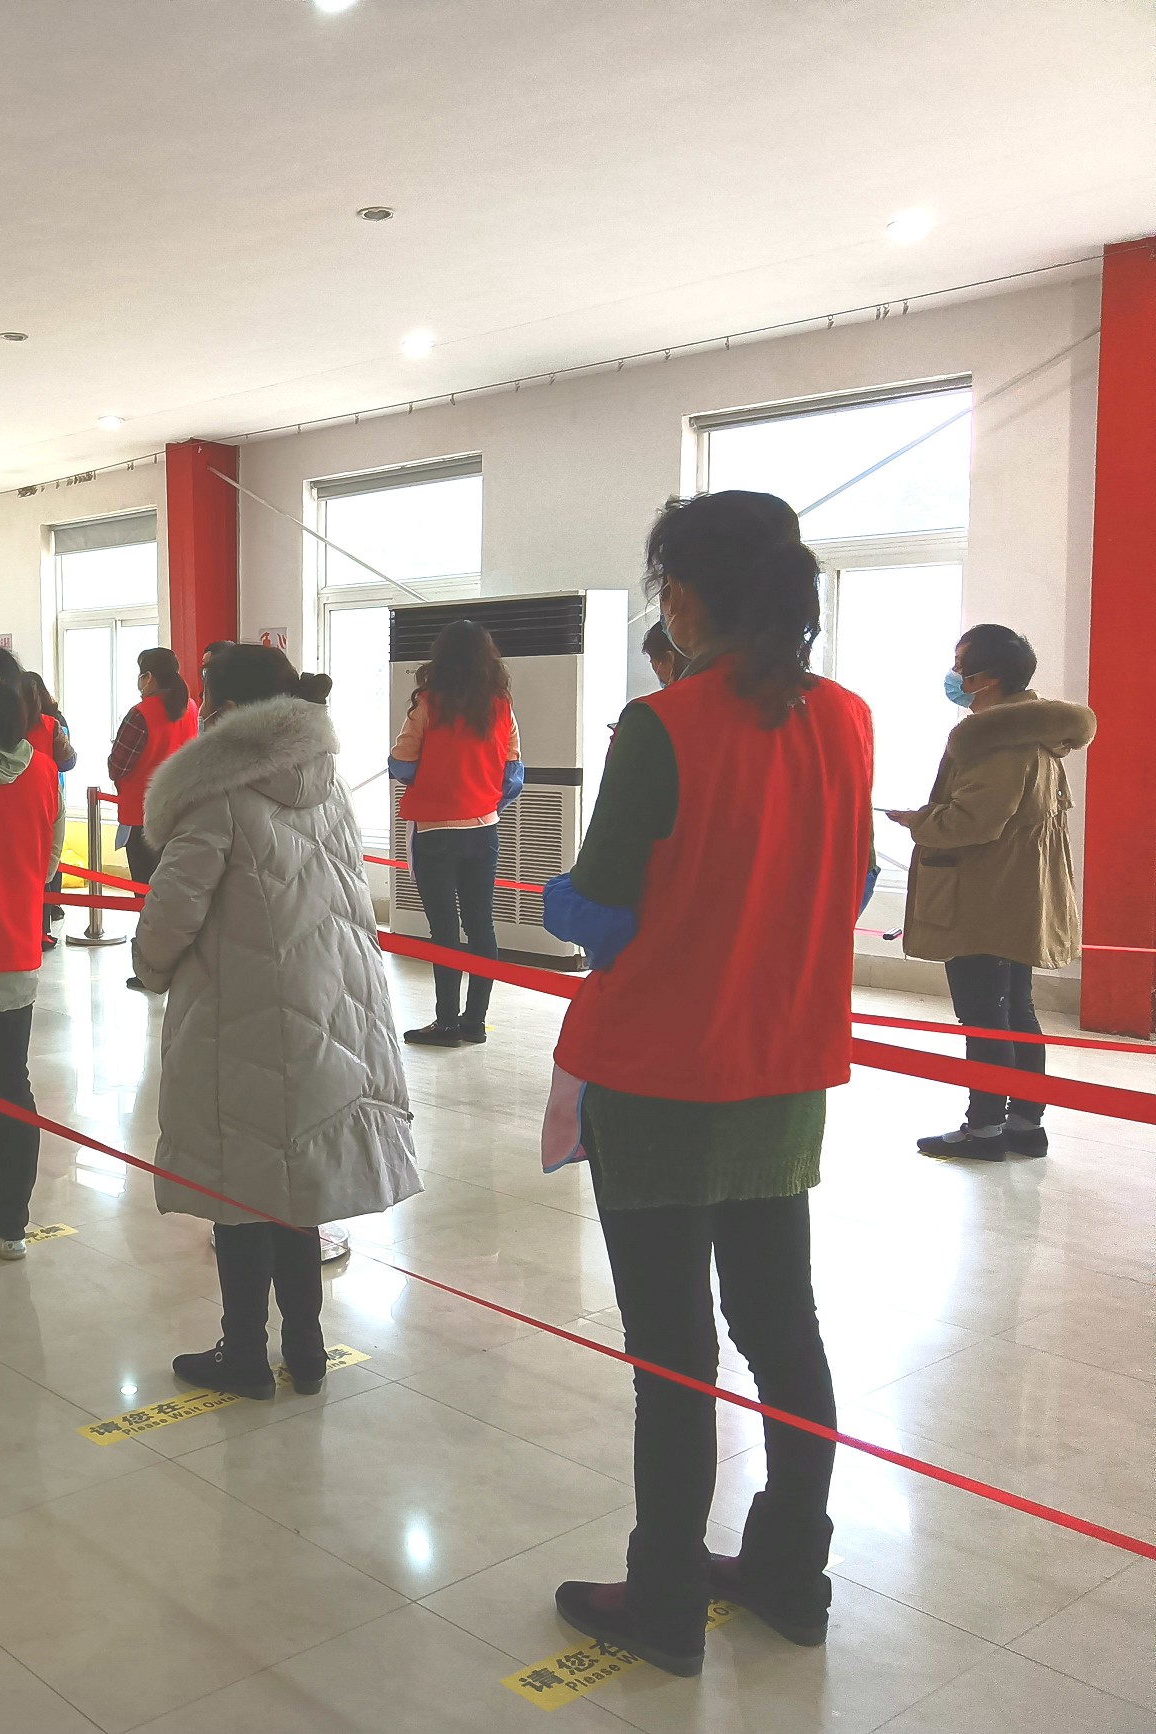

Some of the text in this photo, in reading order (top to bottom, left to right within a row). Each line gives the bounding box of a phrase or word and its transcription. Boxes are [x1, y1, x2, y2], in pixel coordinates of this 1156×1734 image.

[122, 1360, 347, 1436] Please Wait Outsi ine
[565, 1664, 620, 1692] Please
